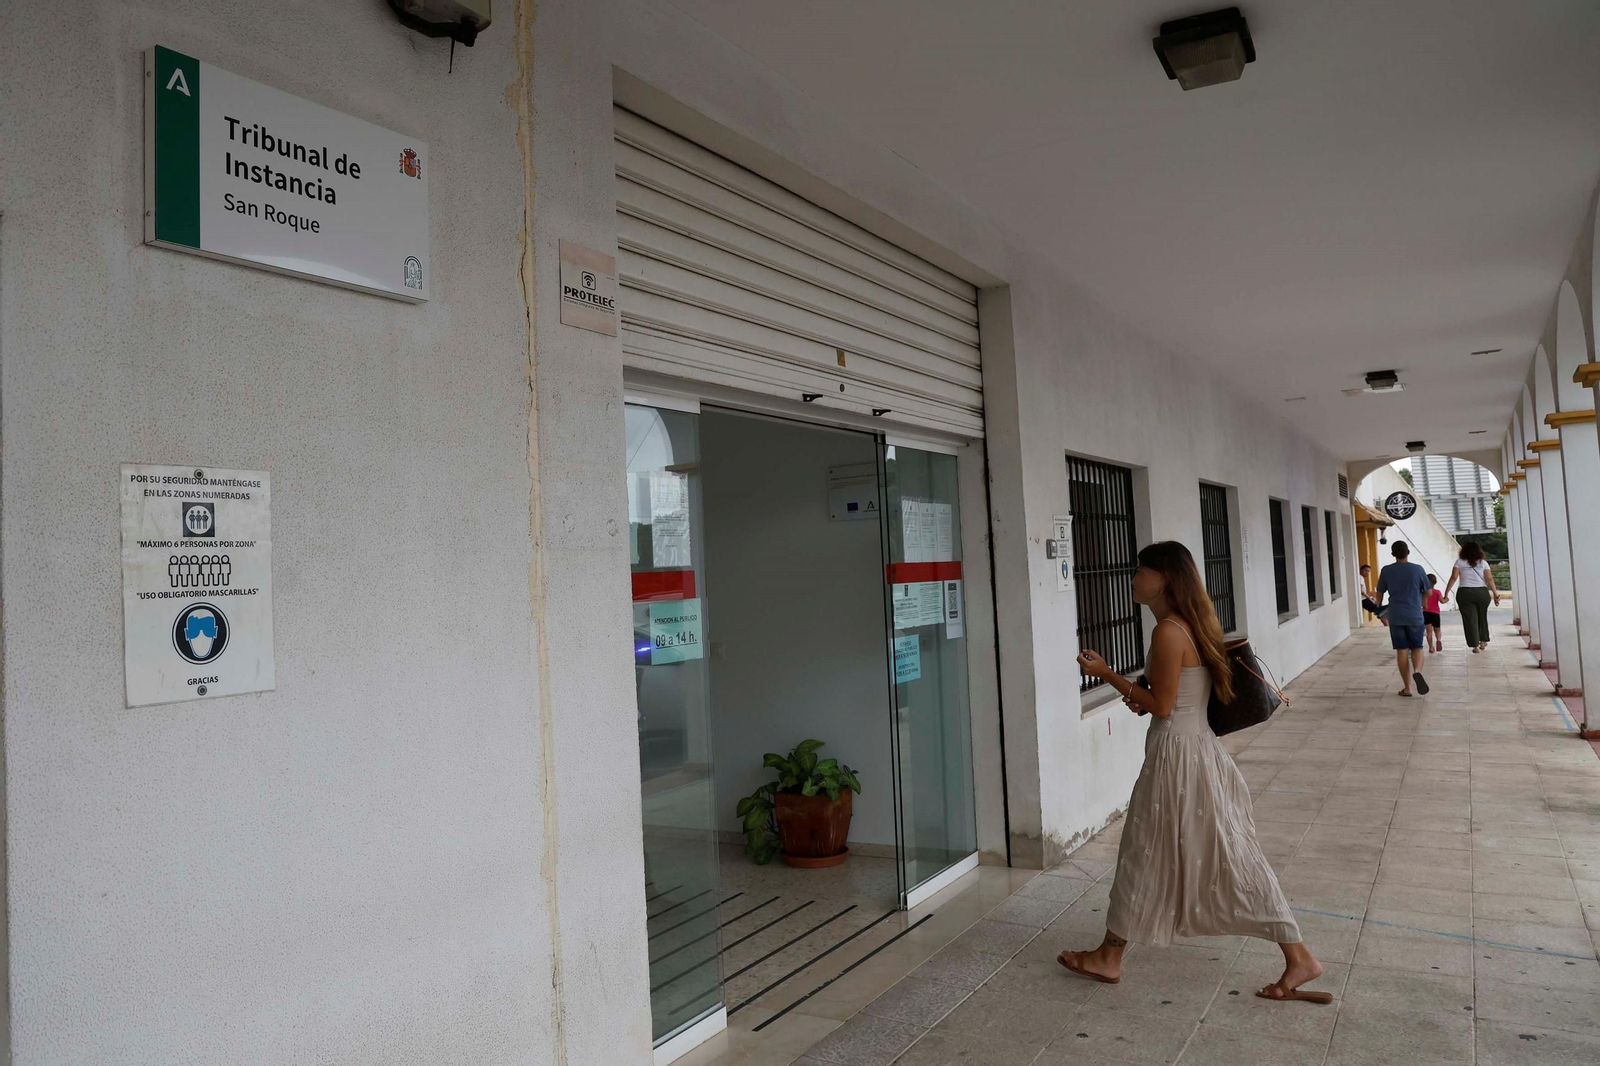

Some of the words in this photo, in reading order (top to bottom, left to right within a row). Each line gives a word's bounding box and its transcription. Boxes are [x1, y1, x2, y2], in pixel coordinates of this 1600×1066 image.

[224, 115, 329, 170] Tribunal
[334, 153, 361, 180] de
[225, 152, 336, 205] Instancia
[223, 193, 258, 218] San
[264, 203, 320, 233] Roque
[564, 285, 615, 308] PROTELEC
[130, 474, 148, 483] POR
[149, 475, 160, 484] SU
[162, 476, 209, 486] SEGURIDAD
[210, 477, 262, 488] MANTÉNGASE
[143, 489, 155, 497] EN
[156, 489, 172, 498] LAS
[173, 490, 201, 499] ZONAS
[202, 491, 251, 500] NUMERADAS
[136, 540, 173, 548] "MÁXIMO
[235, 540, 257, 548] ZONA"
[136, 592, 157, 600] "USO
[157, 589, 207, 599] OBLIGATORIO
[208, 588, 260, 598] MASCARILLAS"
[656, 635, 666, 647] 09
[668, 636, 673, 645] a
[676, 632, 686, 644] 14
[689, 631, 697, 642] h.
[187, 676, 219, 685] GRACIAS
